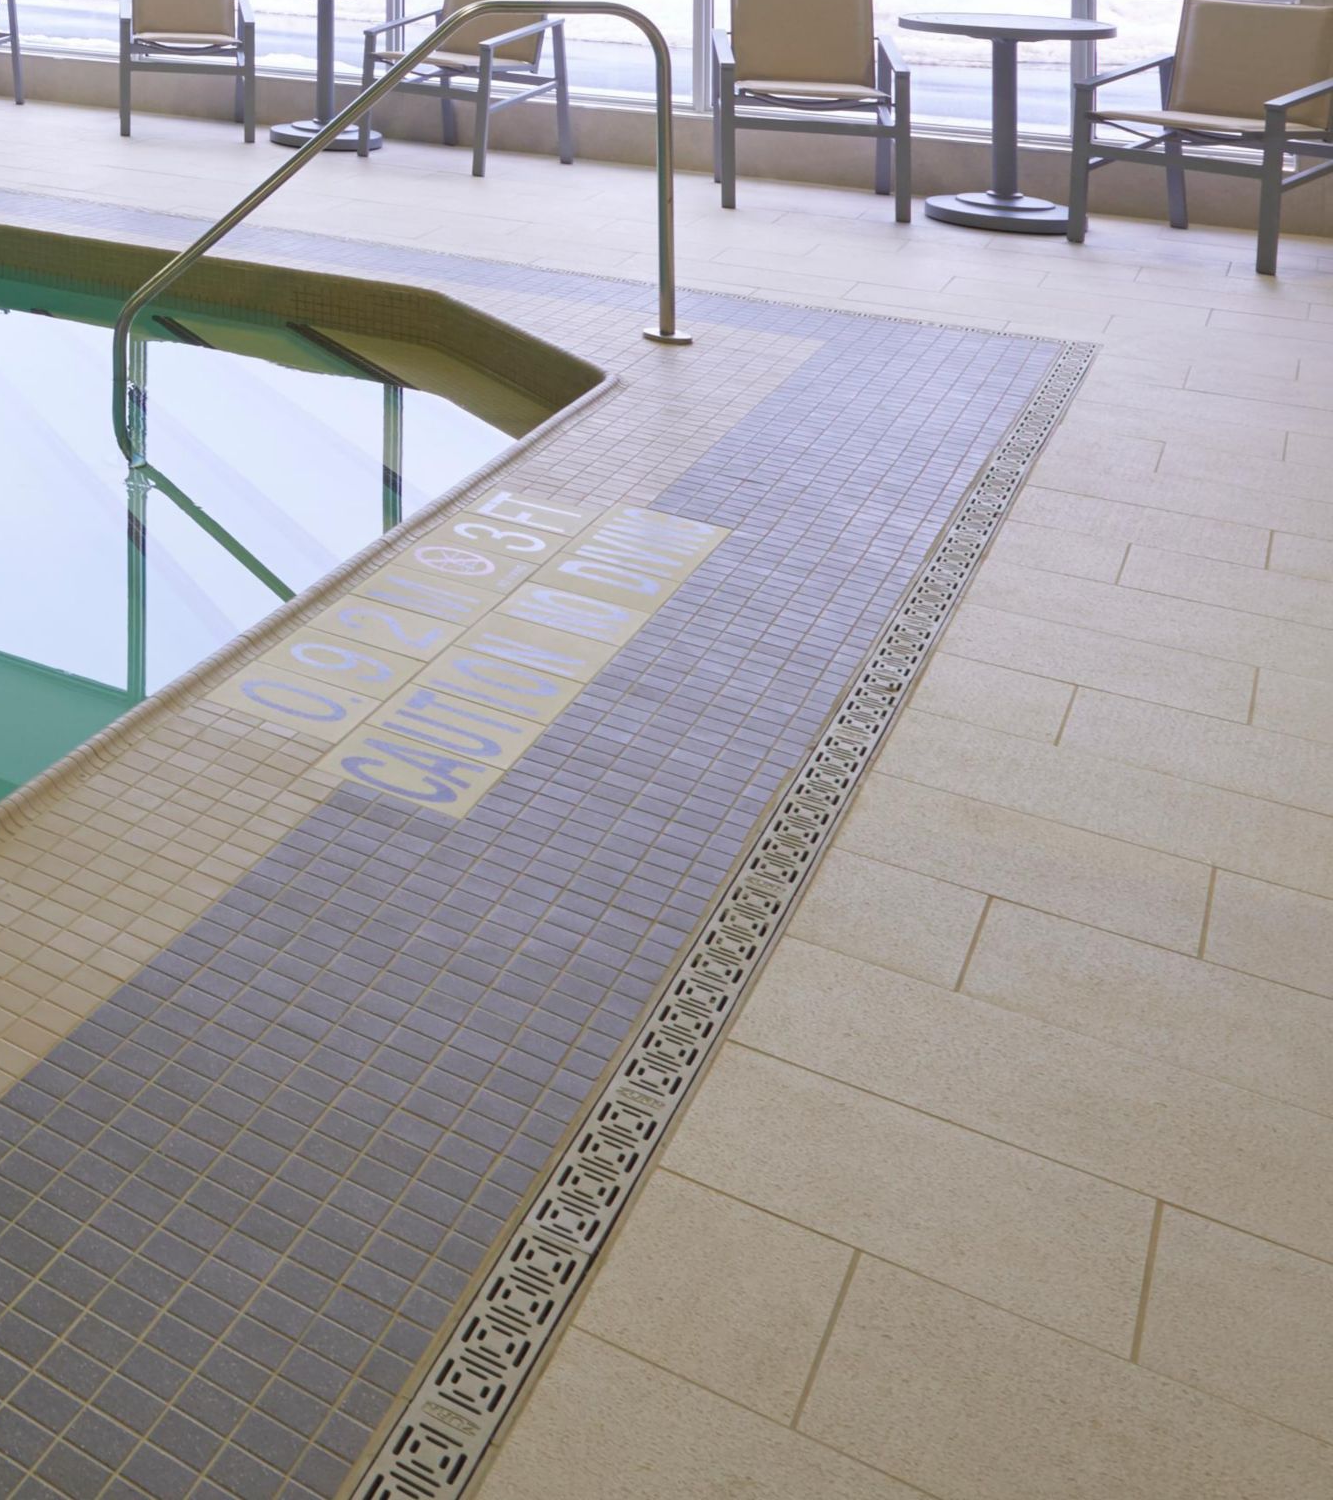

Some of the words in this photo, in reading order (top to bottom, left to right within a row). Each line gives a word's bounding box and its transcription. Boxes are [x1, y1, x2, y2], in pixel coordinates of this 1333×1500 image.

[557, 508, 717, 596] DIVING
[509, 589, 630, 642] NO
[340, 632, 587, 804] CAUTION
